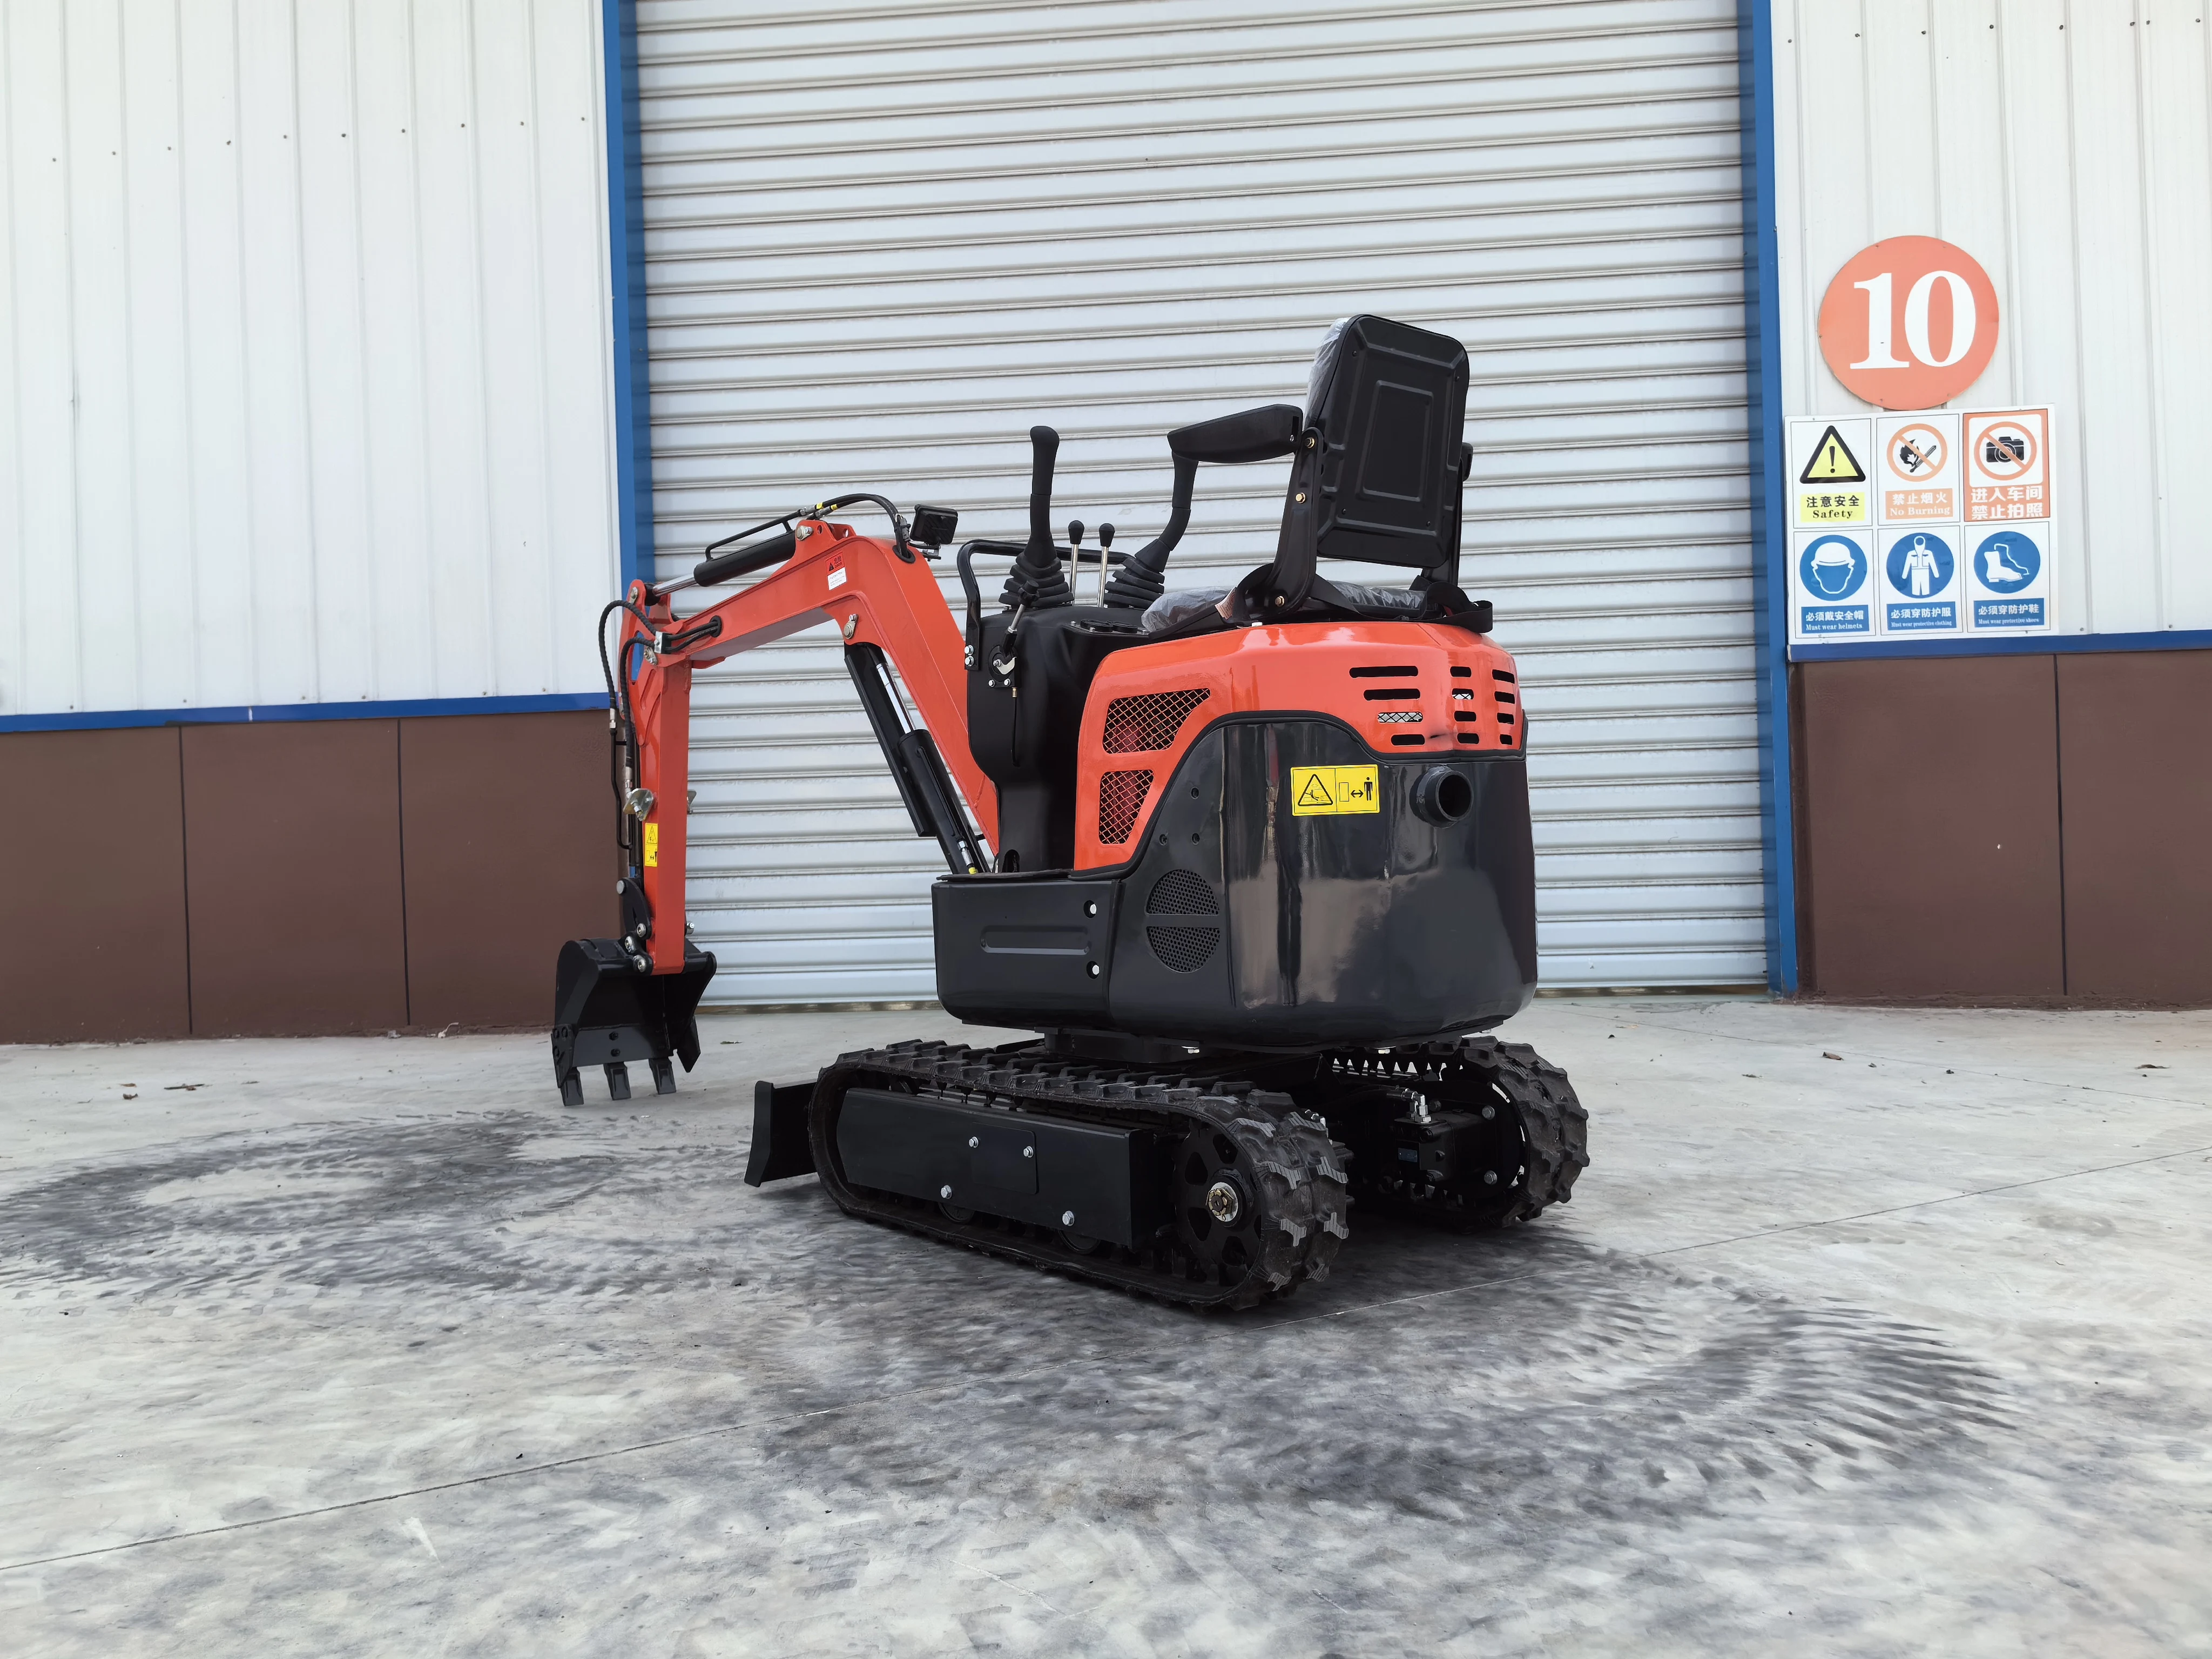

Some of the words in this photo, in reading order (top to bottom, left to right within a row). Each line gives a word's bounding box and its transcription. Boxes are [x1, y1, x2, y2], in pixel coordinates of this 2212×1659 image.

[1850, 270, 1976, 369] 10
[1892, 492, 1947, 505] 禁止烟火
[1971, 485, 2042, 503] 进入车间
[1806, 495, 1859, 508] 注意安全
[1812, 510, 1853, 519] Safety
[1890, 508, 1905, 516] No
[1908, 506, 1951, 516] Burning
[1972, 502, 2043, 520] 禁止拍照
[1891, 607, 1951, 619] 必须穿防护服
[1978, 603, 2039, 615] 必须穿防护鞋
[1805, 610, 1864, 622] 必须戴安全帽
